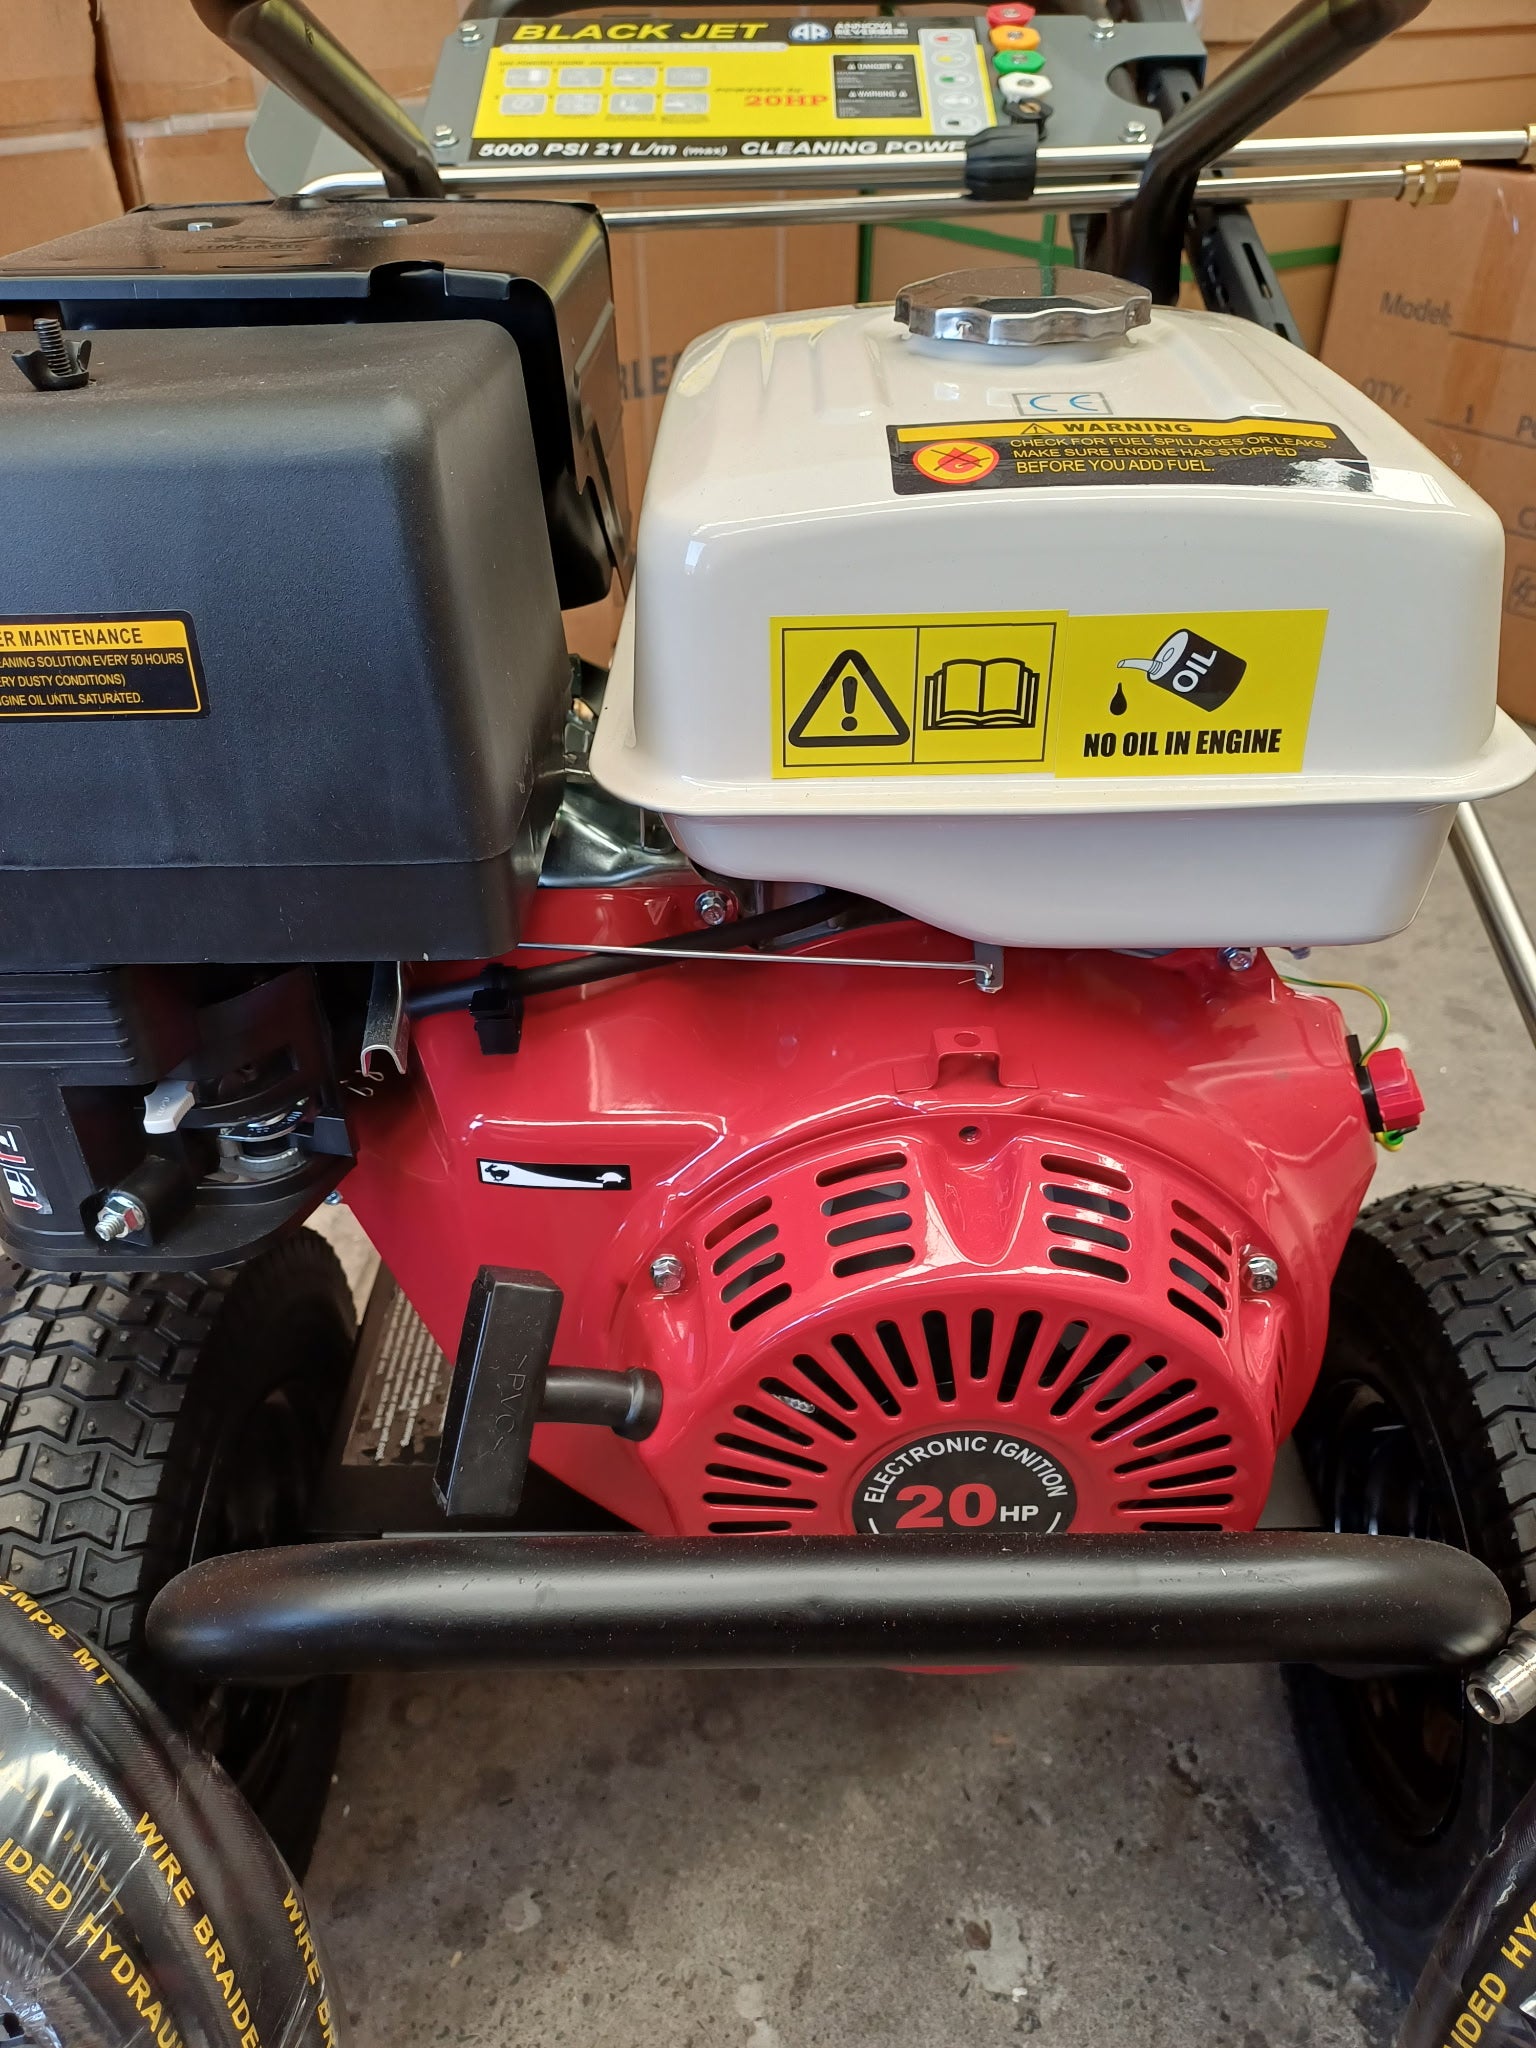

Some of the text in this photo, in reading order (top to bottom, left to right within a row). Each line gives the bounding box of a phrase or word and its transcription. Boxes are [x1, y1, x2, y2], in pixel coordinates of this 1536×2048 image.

[512, 22, 769, 41] BLACK JET
[745, 95, 829, 107] 20HP
[478, 142, 540, 157] 5000
[543, 142, 590, 157] PSI
[593, 142, 623, 156] 21
[629, 142, 678, 156] L/m
[682, 144, 728, 158] (max)
[740, 141, 878, 156] CLEANING
[1062, 423, 1193, 433] WARNING
[1010, 436, 1332, 450] CHECK FOR FUEL SPILLAGES OR LEAKS.
[1013, 446, 1298, 459] MAKE SURE ENGINE HAS STOPPED
[1016, 459, 1215, 474] BEFORE YOU ADD FUEL.
[18, 627, 143, 647] MAINTENANCE
[37, 655, 92, 668] SOLUTION
[93, 653, 129, 667] EVERY
[130, 653, 143, 666] 50
[145, 652, 184, 665] HOURS
[17, 674, 53, 687] DUSTY
[55, 672, 126, 687] CONDITIONS)
[1172, 650, 1218, 693] OIL
[28, 693, 46, 706] OIL
[47, 693, 78, 705] UNTIL
[78, 692, 144, 705] SATURATED.
[1083, 728, 1282, 758] NO OIL IN ENGINE
[863, 1436, 1069, 1504] ELECTRONIC IGNITION
[134, 1811, 262, 2048] WIRE BRAIDE
[282, 1888, 320, 1985] WIRE
[76, 1911, 183, 2048] HYDRAU
[1442, 1972, 1507, 2048] IDED
